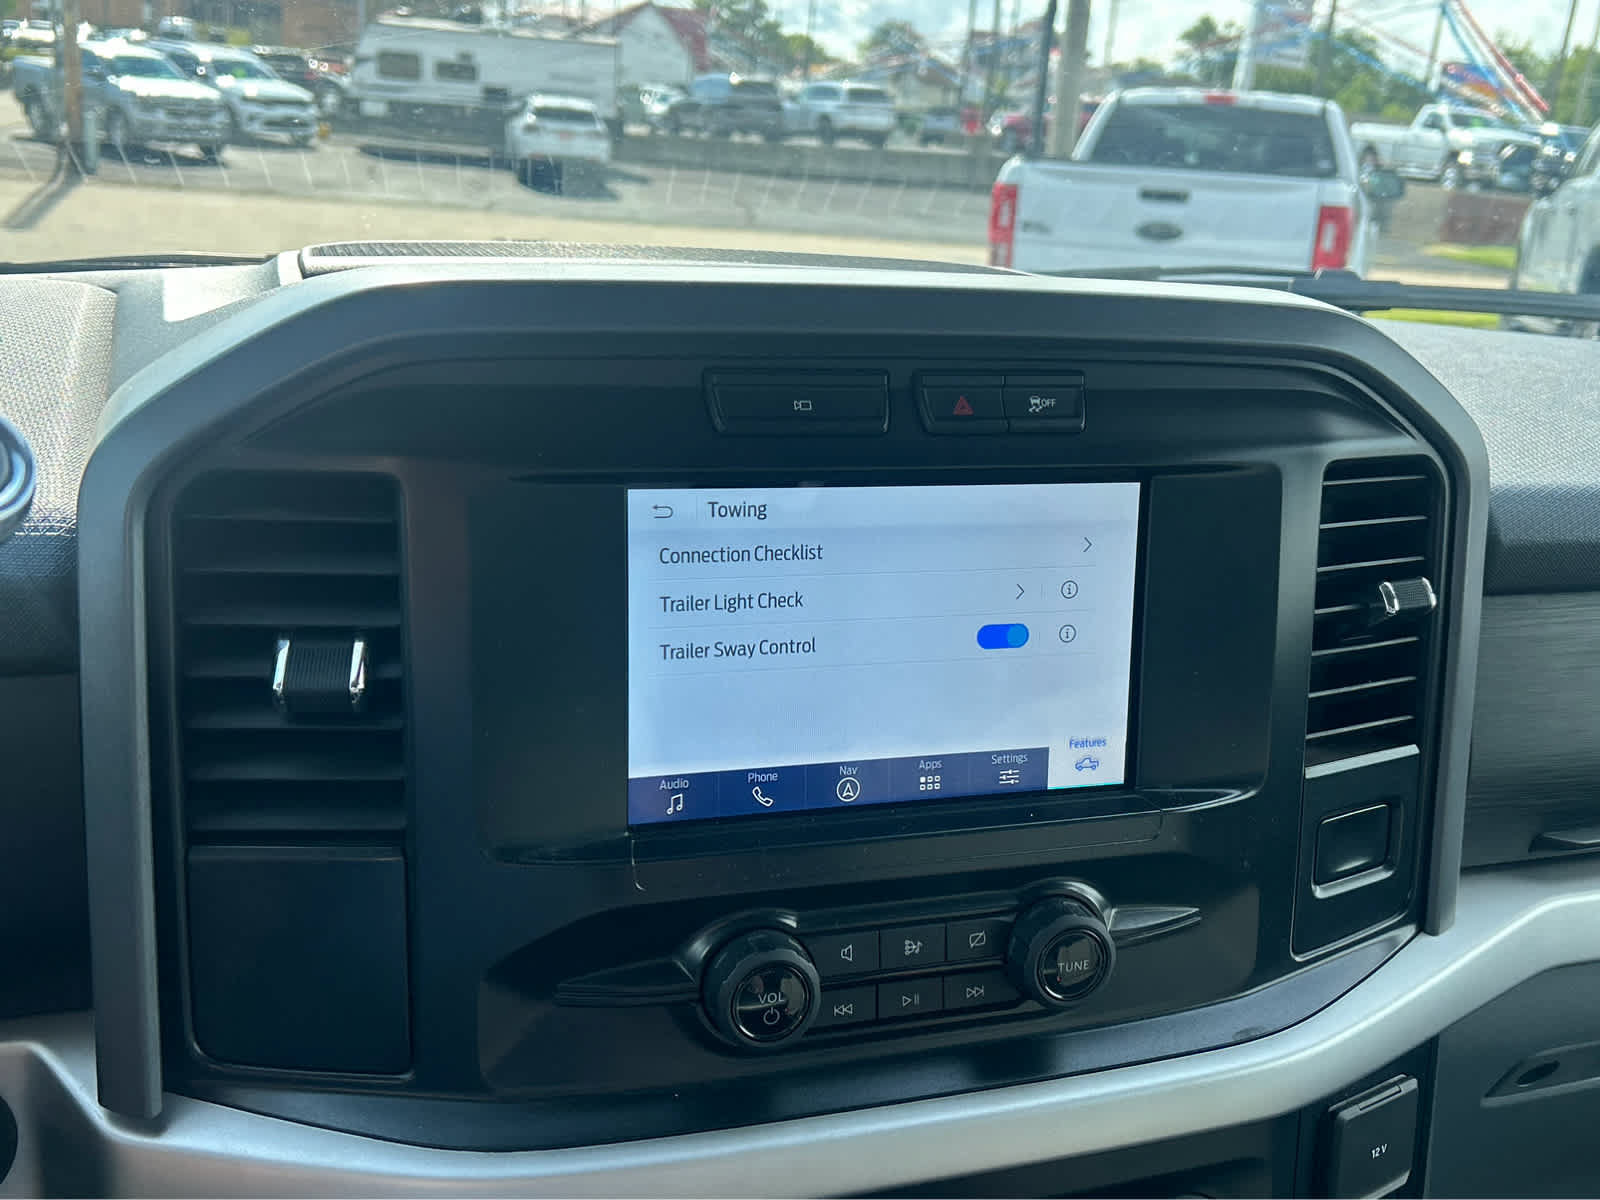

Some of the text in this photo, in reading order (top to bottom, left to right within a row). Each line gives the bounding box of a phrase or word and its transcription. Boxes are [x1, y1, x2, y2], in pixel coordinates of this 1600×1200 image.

[1041, 398, 1056, 408] OFF
[708, 501, 768, 520] Towing
[660, 544, 823, 564] Connection Checklist
[659, 592, 804, 613] Trailer Light Check
[659, 637, 816, 660] Trailer Sway Control
[1069, 737, 1107, 749] Features
[919, 759, 943, 772] Apps
[991, 753, 1028, 766] Settings
[839, 765, 858, 775] Nav
[747, 772, 778, 783] Phone
[659, 778, 689, 791] Audio
[1058, 959, 1090, 973] TUNE
[758, 993, 785, 1004] VOL
